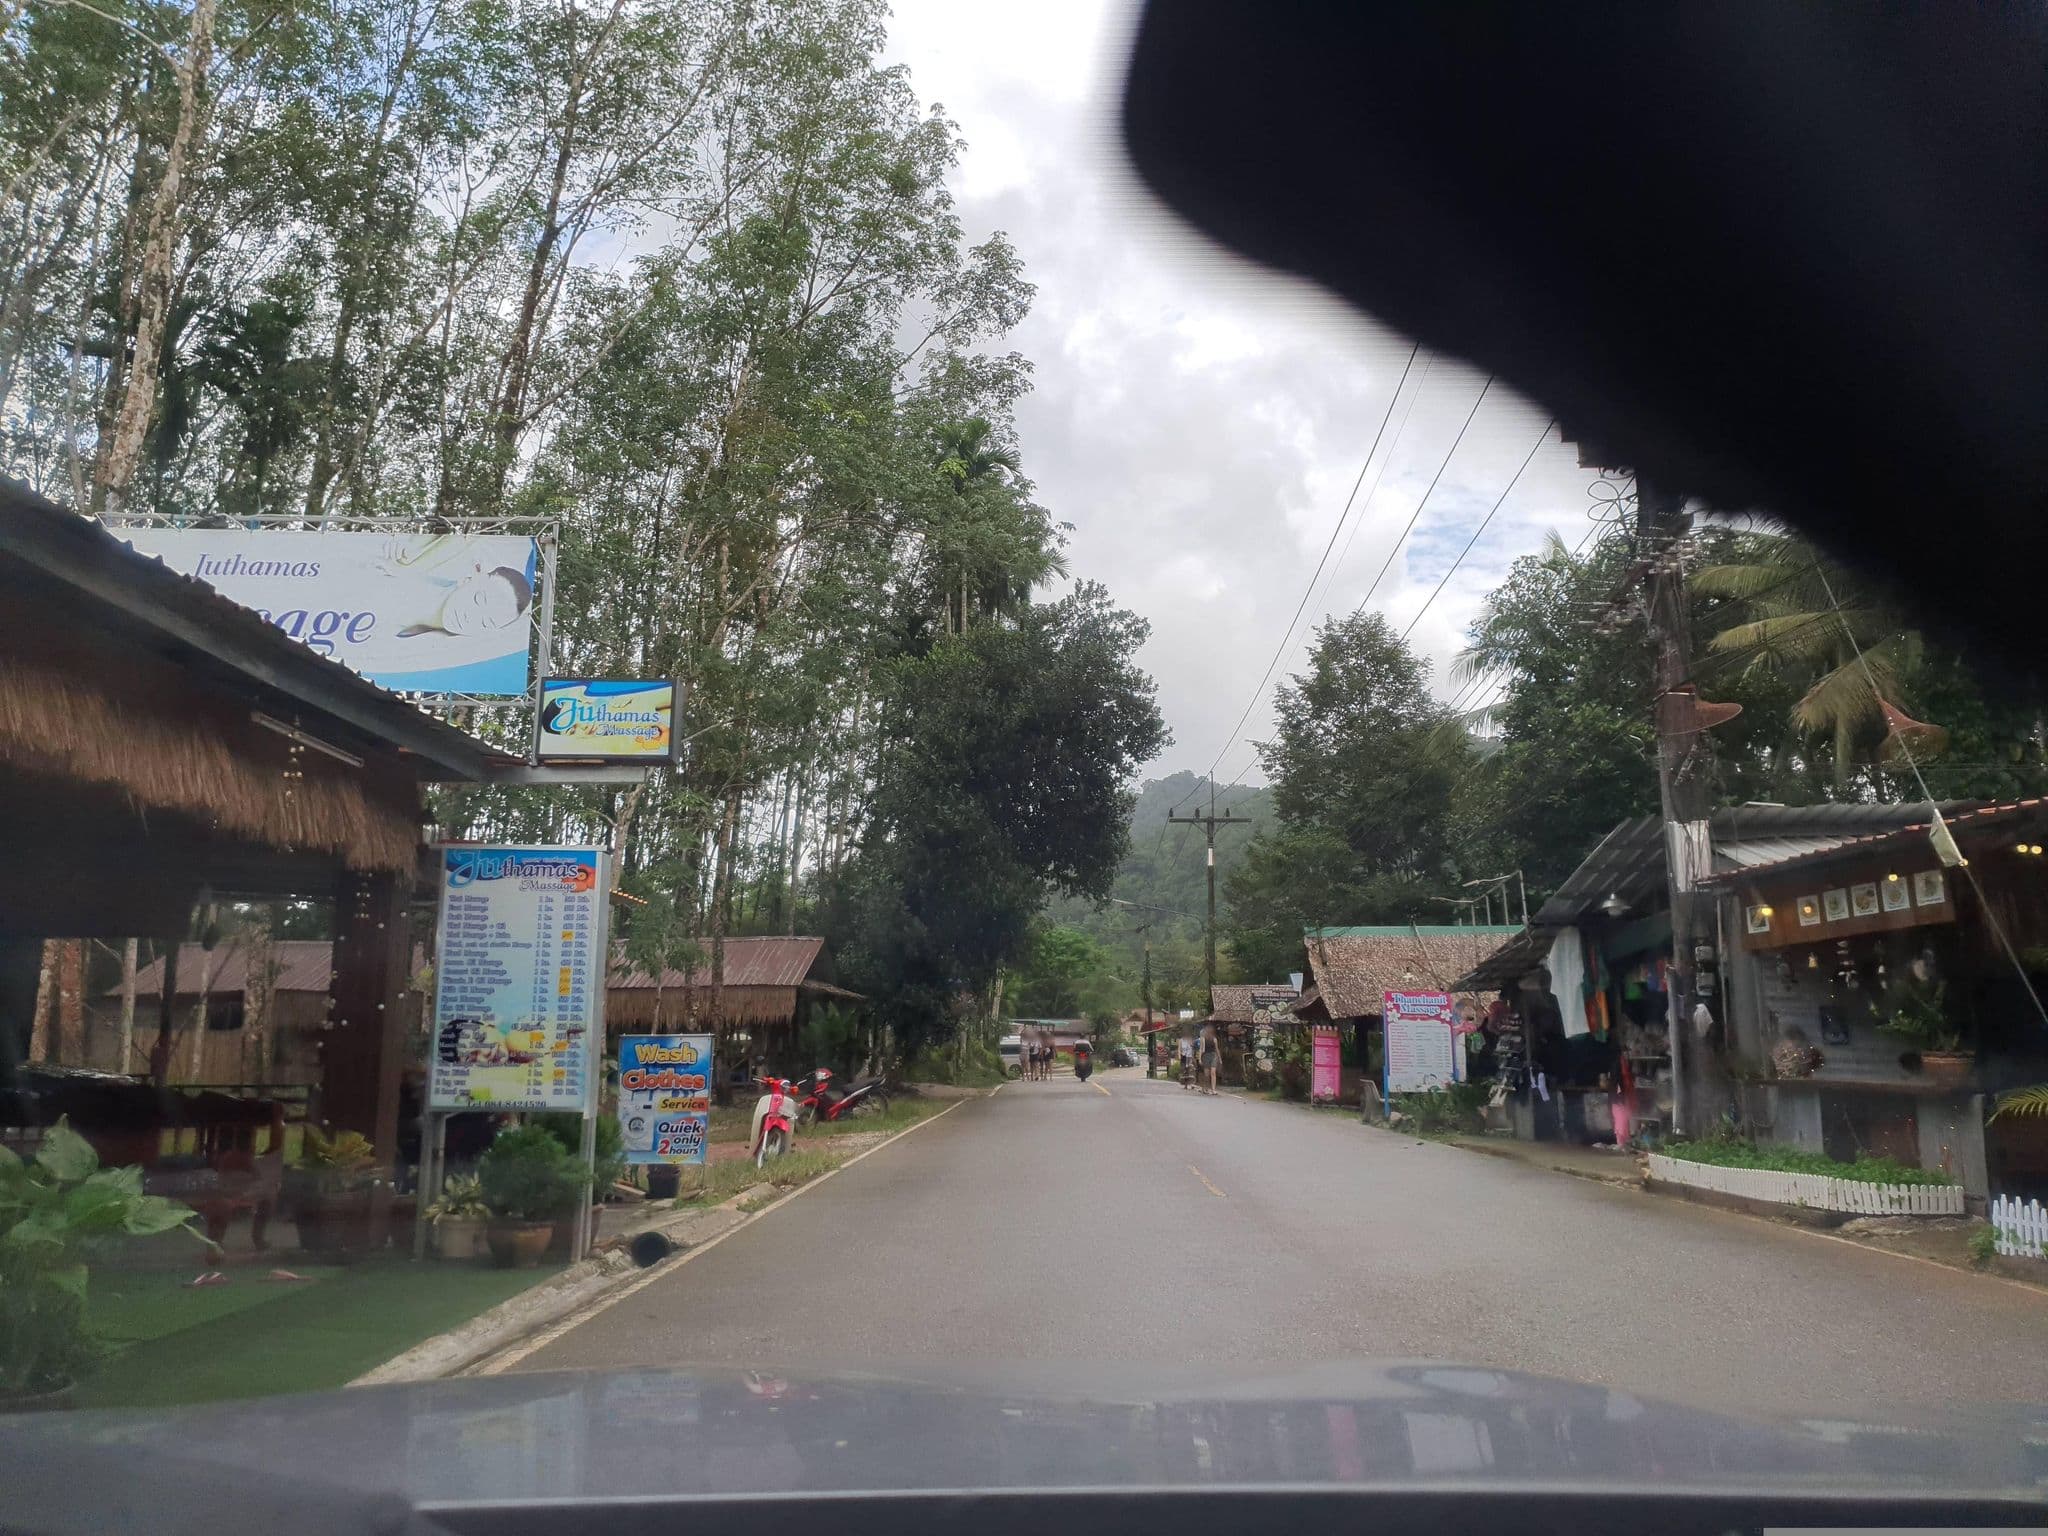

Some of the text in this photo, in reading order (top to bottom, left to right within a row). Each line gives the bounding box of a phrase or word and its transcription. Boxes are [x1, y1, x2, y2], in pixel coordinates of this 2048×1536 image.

[194, 553, 321, 578] Juthamas
[550, 697, 659, 731] Juthamas
[597, 724, 659, 740] Massage
[448, 850, 579, 888] Juthamas
[520, 879, 576, 893] Massage
[1401, 1004, 1440, 1016] Massage
[635, 1044, 697, 1063] Wash
[623, 1069, 705, 1089] Clothes
[660, 1099, 705, 1110] Service
[657, 1139, 699, 1155] 2 hours
[673, 1134, 701, 1147] only
